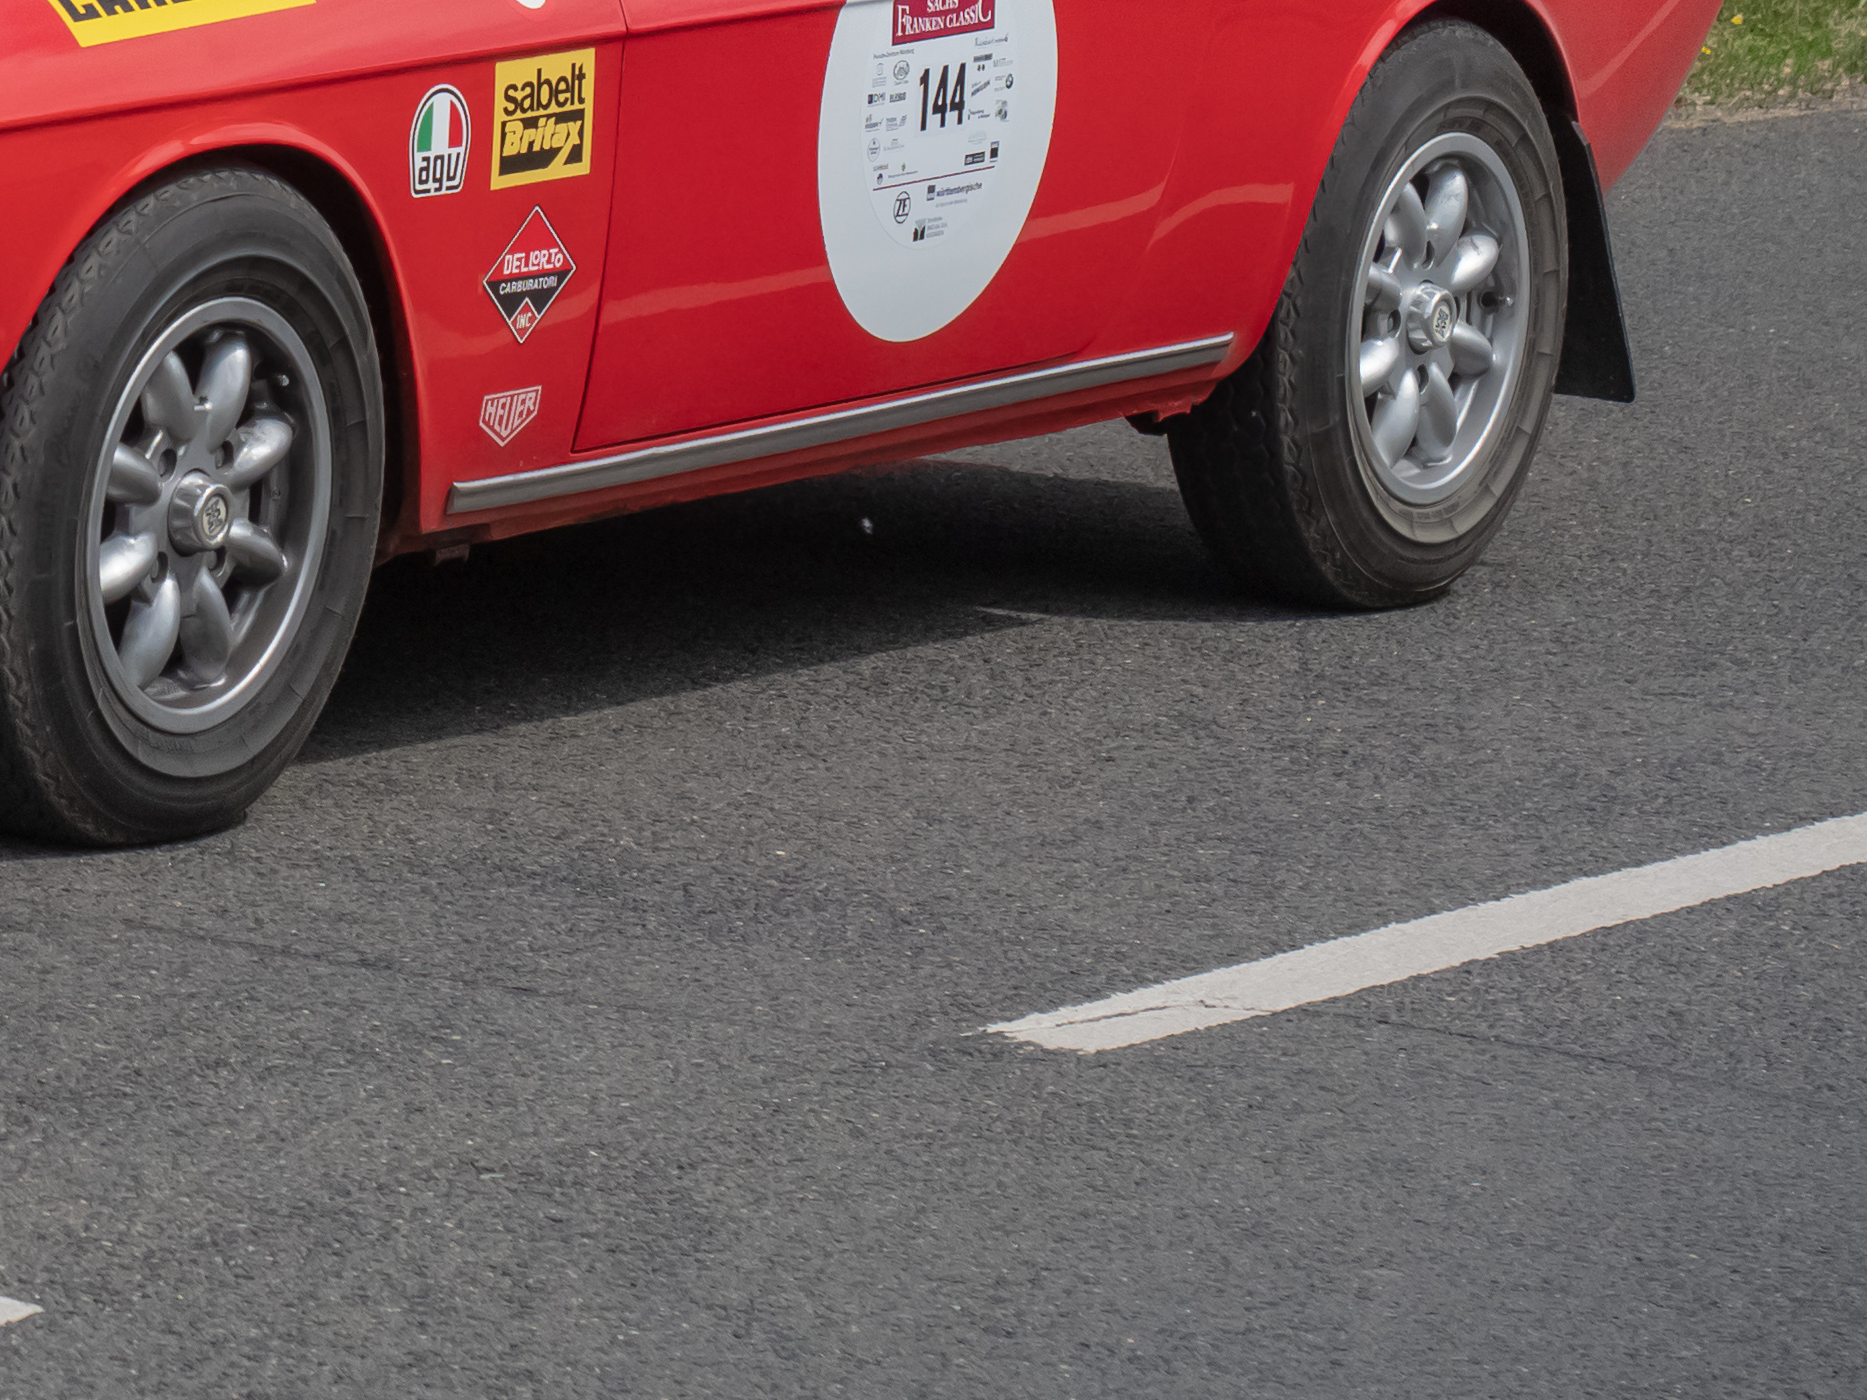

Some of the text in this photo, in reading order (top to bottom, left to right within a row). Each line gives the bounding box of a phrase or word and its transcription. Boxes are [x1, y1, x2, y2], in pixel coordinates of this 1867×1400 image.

[895, 4, 946, 37] FRANKEN
[503, 62, 586, 117] sabelt
[918, 62, 966, 132] 144
[502, 116, 583, 158] Britax
[418, 151, 461, 194] agv
[499, 275, 558, 295] CARBURATORI
[484, 391, 537, 438] HEUER
